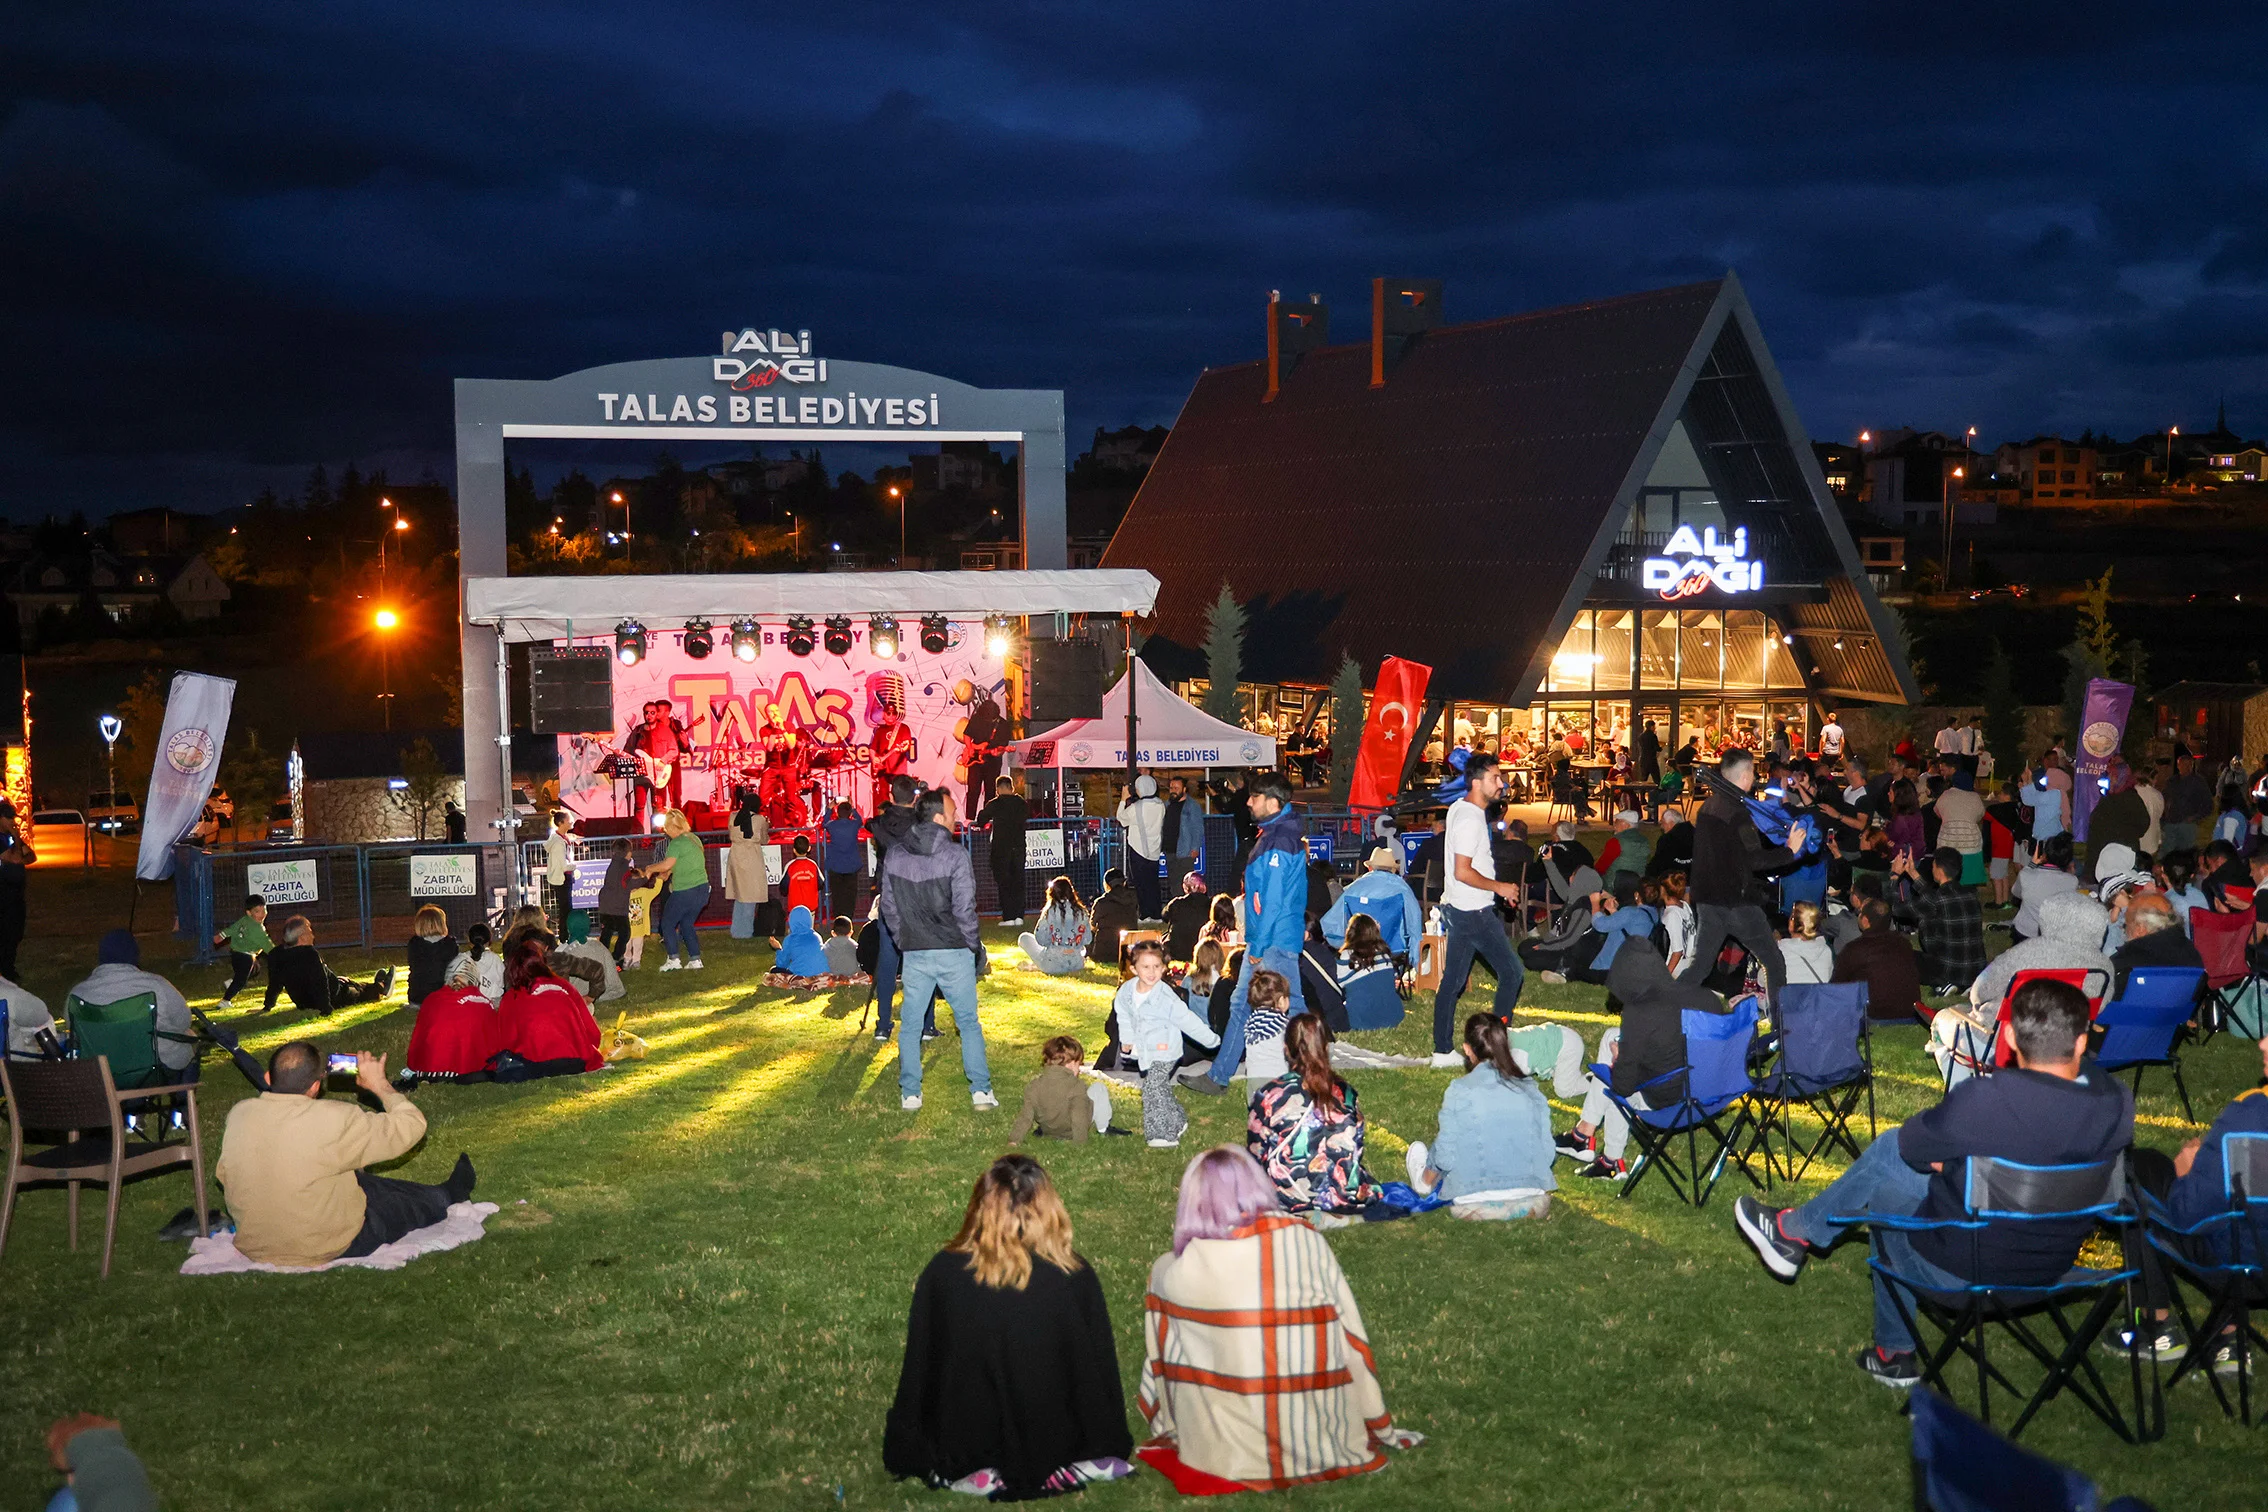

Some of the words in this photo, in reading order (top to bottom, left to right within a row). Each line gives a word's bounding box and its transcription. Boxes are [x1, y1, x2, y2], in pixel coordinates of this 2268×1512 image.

[736, 366, 780, 391] 360
[598, 393, 718, 422] TALAS
[729, 392, 939, 425] BELEDİYESİ
[1664, 572, 1711, 600] 360
[1115, 750, 1150, 762] TAAS
[1156, 747, 1219, 762] BELEDİYESİ
[1026, 848, 1054, 857] ABITA
[423, 875, 463, 884] ZABITA
[262, 881, 304, 893] ZABITA
[413, 885, 474, 895] MÜDÜRLÜĞÜ
